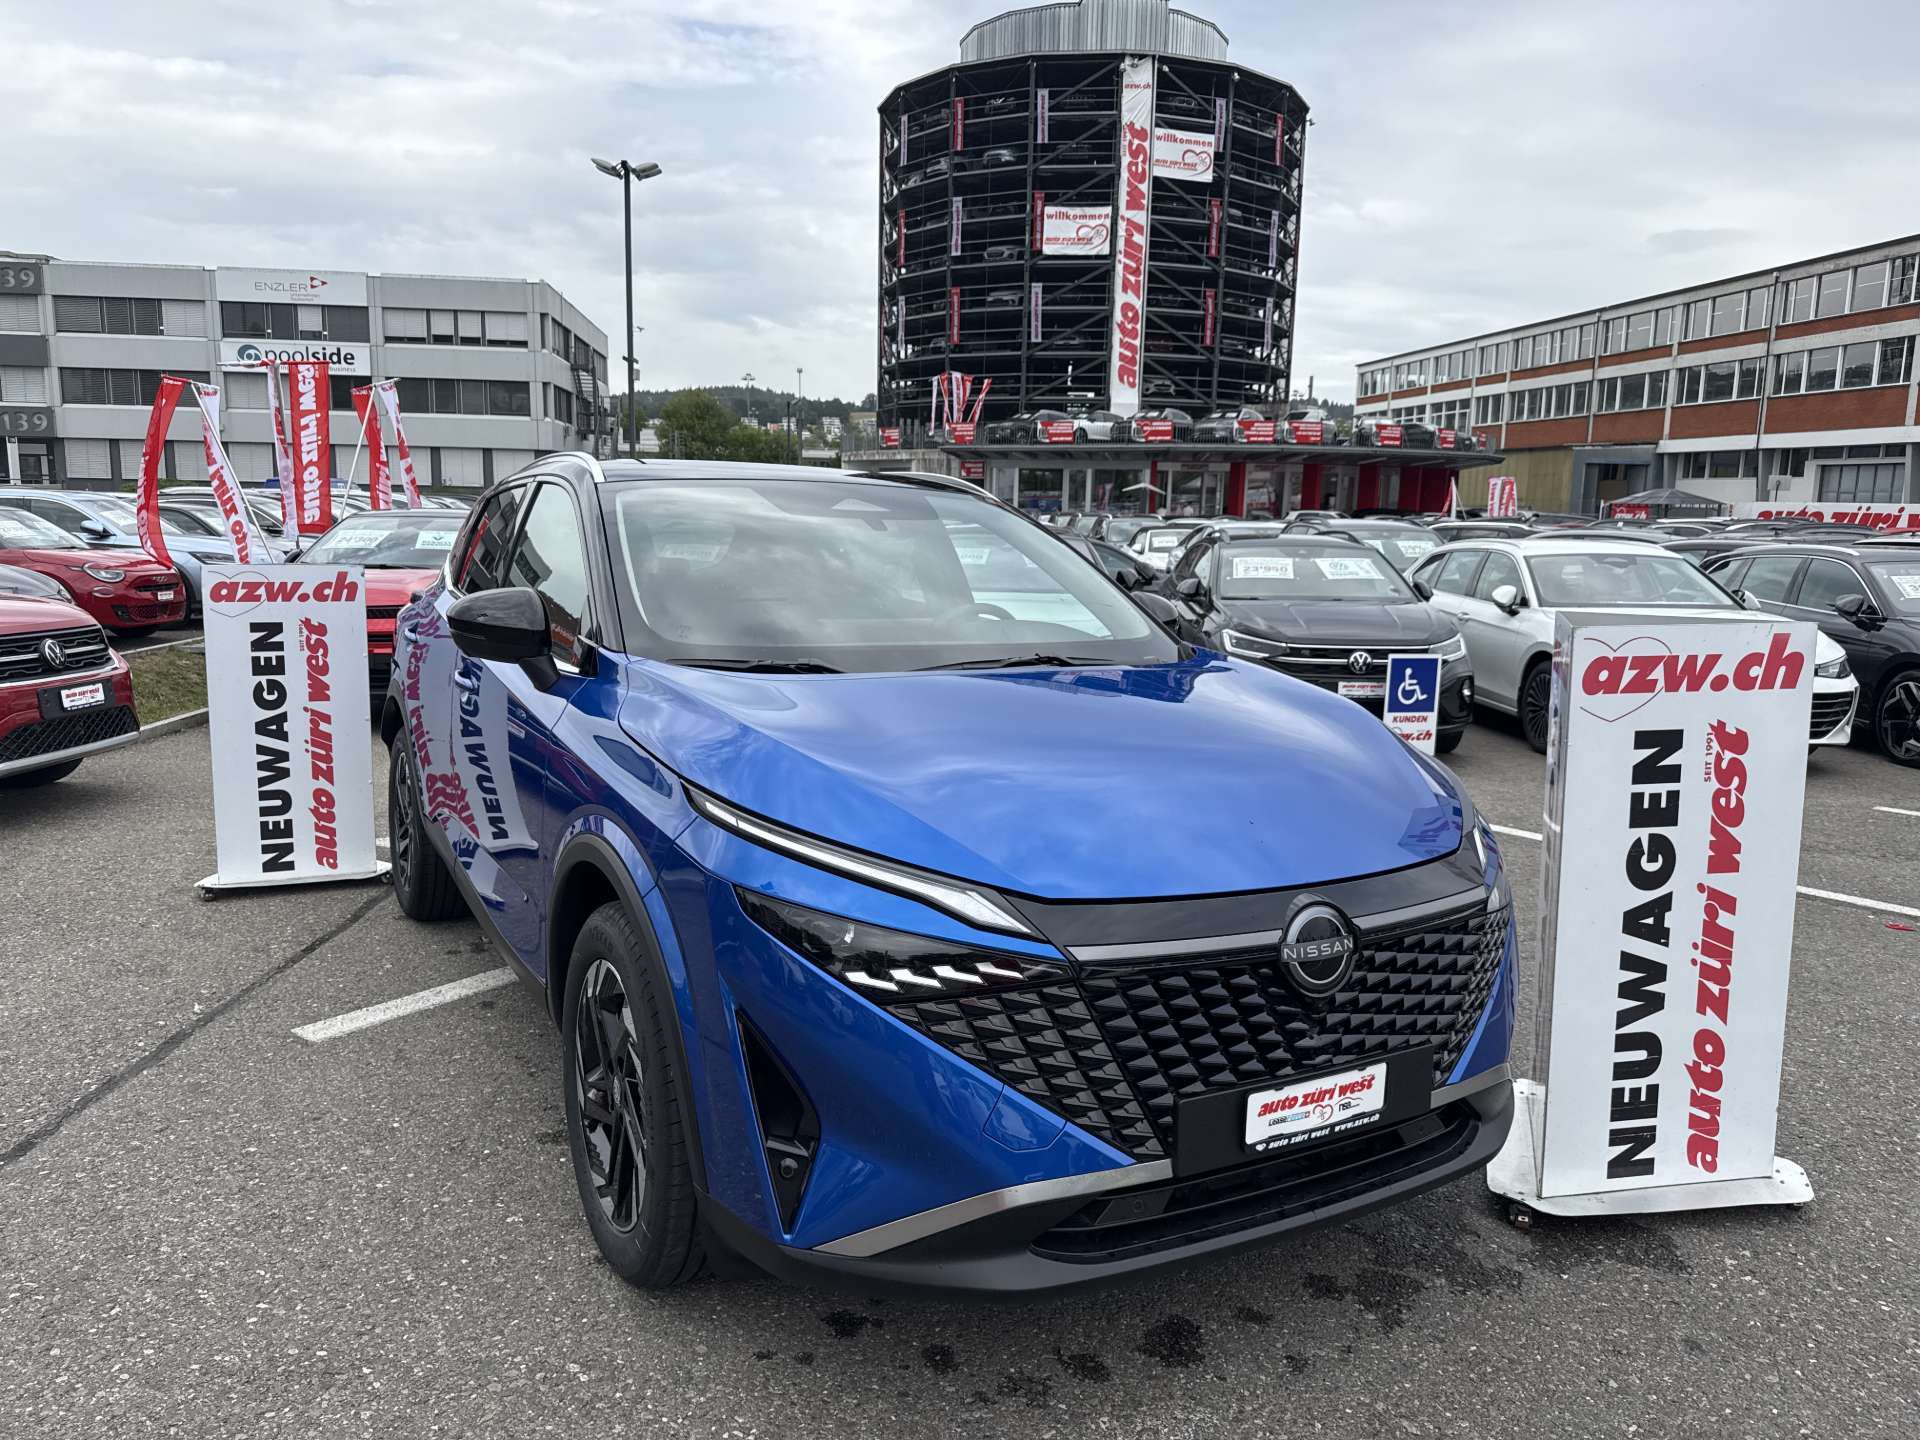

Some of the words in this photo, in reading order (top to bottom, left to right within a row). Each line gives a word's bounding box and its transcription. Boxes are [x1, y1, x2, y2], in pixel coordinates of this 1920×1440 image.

[1125, 120, 1149, 211] west
[1155, 132, 1213, 148] willkommen
[1045, 210, 1110, 221] willkommen
[1117, 214, 1145, 300] züri
[254, 281, 308, 293] ENZLER
[264, 345, 356, 366] poolside
[1116, 302, 1140, 389] auto
[1, 412, 48, 432] 139
[209, 571, 358, 603] azw.ch
[299, 616, 332, 702] west
[1581, 632, 1806, 695] azw.ch
[1392, 715, 1428, 723] KUNDEN
[1705, 731, 1714, 755] 1991
[249, 622, 296, 873] NEUWAGEN
[303, 706, 335, 787] züri
[1703, 757, 1712, 783] SEIT
[1707, 719, 1751, 874] west
[310, 788, 338, 870] auto
[1283, 938, 1354, 960] NISSAN
[1606, 728, 1685, 1181] NEUWAGEN
[1690, 881, 1738, 1026] züri
[1257, 1094, 1299, 1118] auto
[1299, 1083, 1338, 1107] züri
[1338, 1075, 1376, 1097] west
[1682, 1027, 1727, 1176] auto
[1268, 1138, 1289, 1150] auto
[1310, 1127, 1331, 1139] west
